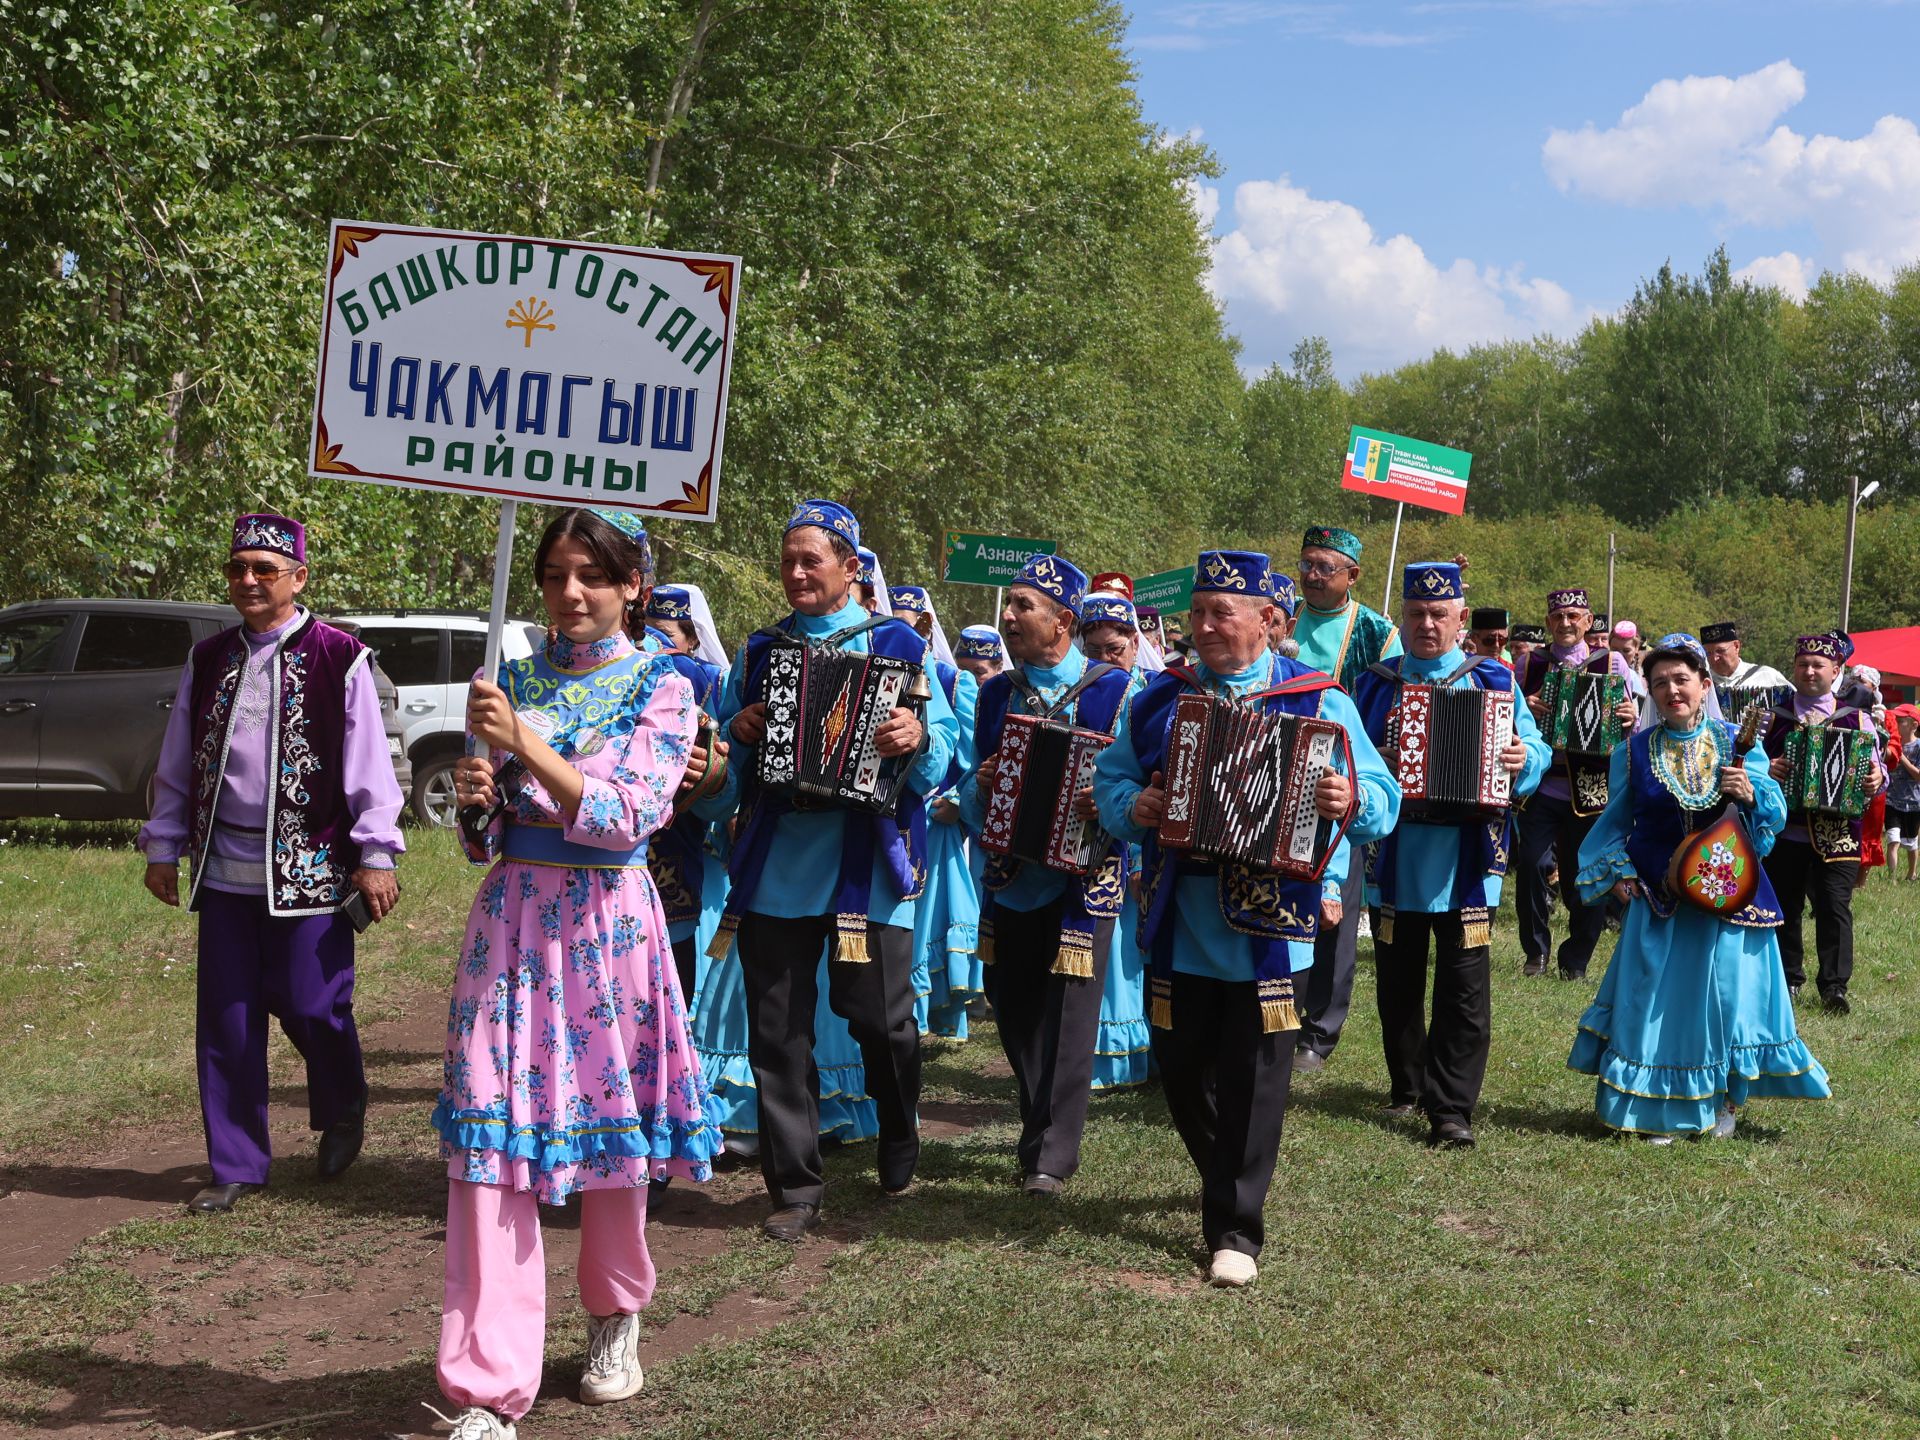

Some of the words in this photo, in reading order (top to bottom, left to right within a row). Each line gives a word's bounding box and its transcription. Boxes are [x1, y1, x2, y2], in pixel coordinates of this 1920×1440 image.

[336, 241, 723, 375] БАШКОРТОСТАН
[348, 339, 699, 452] ЧАКМАГЫШ
[406, 433, 648, 493] РАЙОНЫ
[1412, 454, 1427, 462] КАМА
[1432, 466, 1454, 475] РАЙОНЫ
[1439, 490, 1457, 498] РАЙОН
[988, 565, 1022, 576] район
